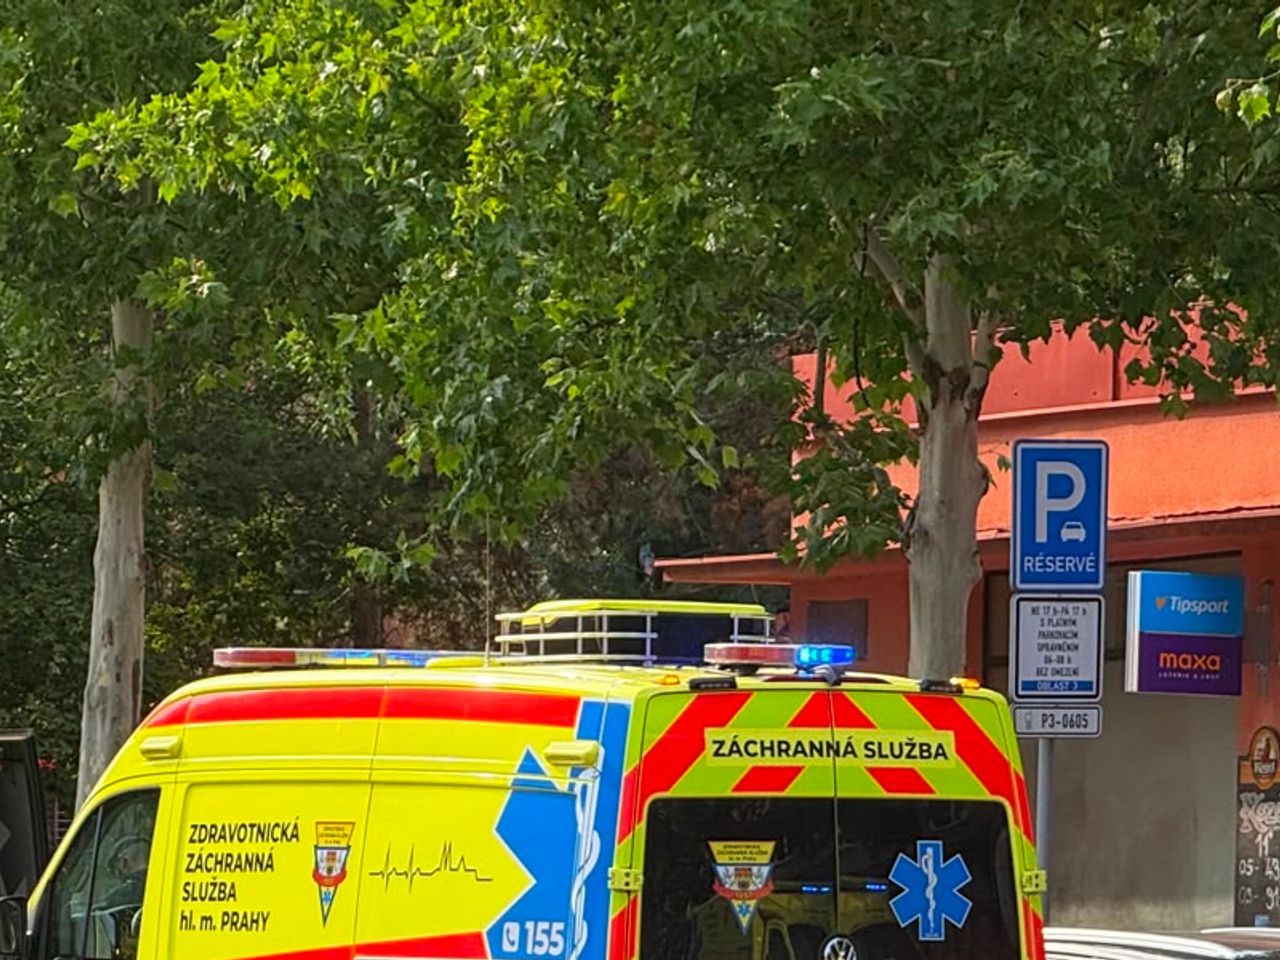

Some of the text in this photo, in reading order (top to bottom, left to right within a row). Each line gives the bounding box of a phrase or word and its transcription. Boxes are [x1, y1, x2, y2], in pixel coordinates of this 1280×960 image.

[1035, 460, 1086, 543] P
[1023, 552, 1097, 573] RÉSERVÉ
[1170, 595, 1230, 616] Tipsport
[1159, 652, 1221, 671] maxa
[1041, 713, 1089, 729] P3-0605
[712, 734, 949, 761] ZÁCHRANNÁ SLUŽBA
[188, 816, 300, 844] ZDRAVOTNICKÁ
[185, 847, 275, 873] ZÁCHRANNÁ
[182, 877, 237, 902] SLUŽBA
[179, 909, 271, 932] hl. m. PRAHY
[524, 920, 565, 956] 155
